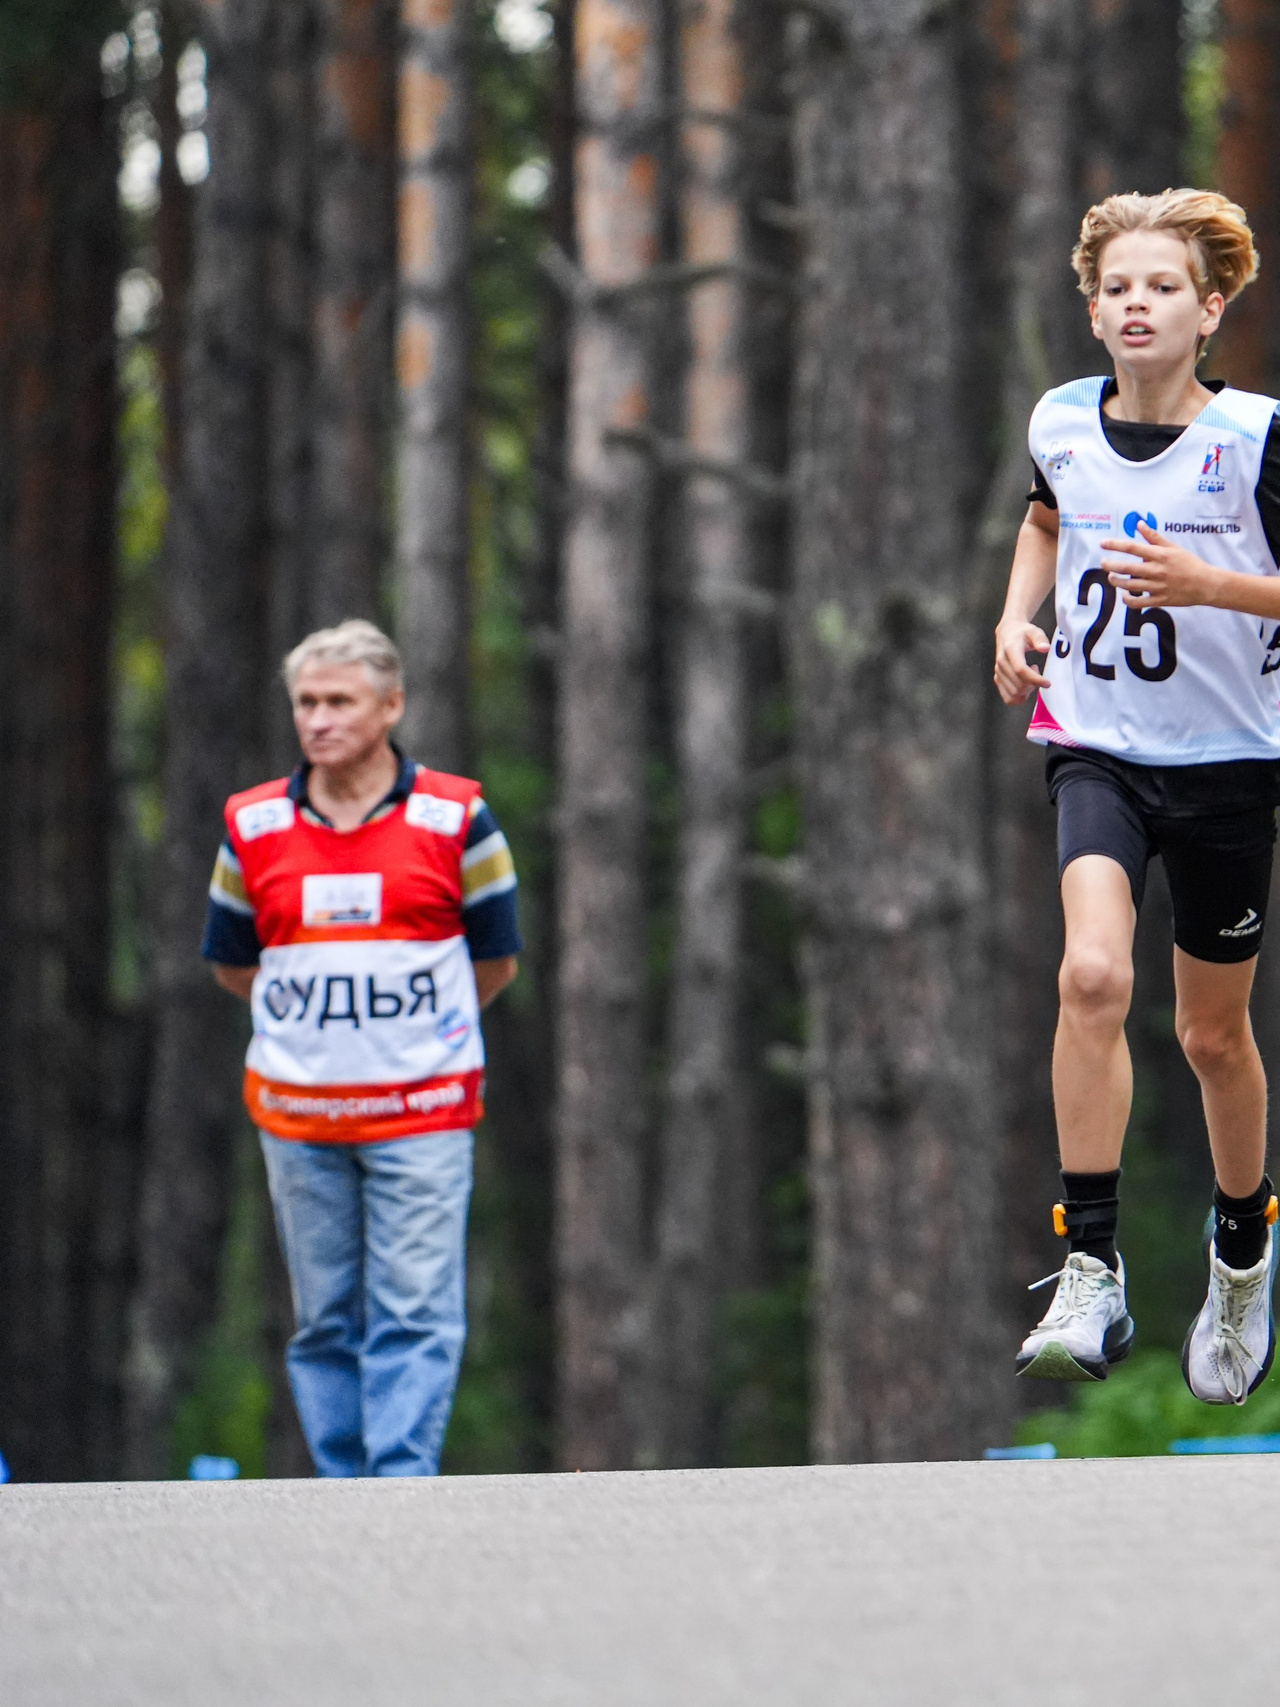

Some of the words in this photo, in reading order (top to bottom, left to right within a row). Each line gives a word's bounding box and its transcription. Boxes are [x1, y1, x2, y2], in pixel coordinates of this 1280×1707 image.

[1164, 522, 1242, 534] НОРНИКЕЛЬ
[1076, 567, 1178, 682] 25
[263, 969, 437, 1030] СУДЬЯ
[1219, 1213, 1238, 1231] 75
